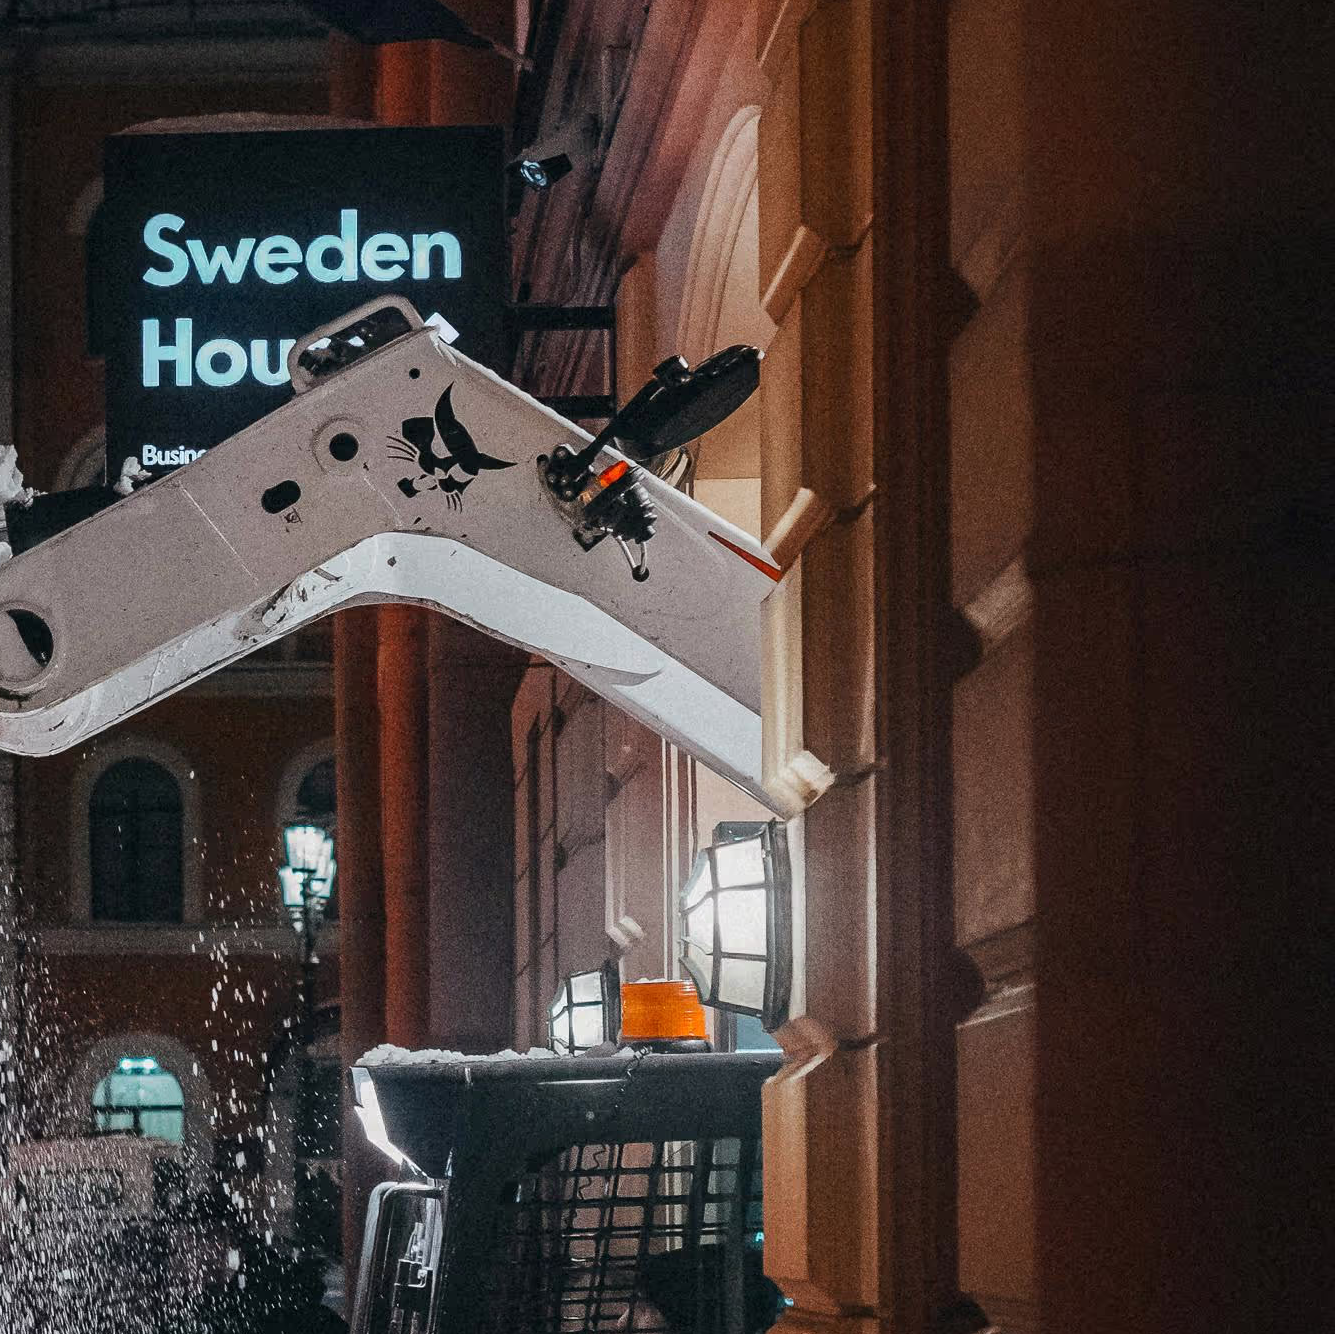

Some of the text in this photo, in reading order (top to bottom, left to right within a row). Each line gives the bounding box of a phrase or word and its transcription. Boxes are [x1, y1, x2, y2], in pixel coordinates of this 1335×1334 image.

[142, 208, 462, 286] Sweden
[142, 317, 297, 387] Hou
[142, 444, 208, 466] Busin
